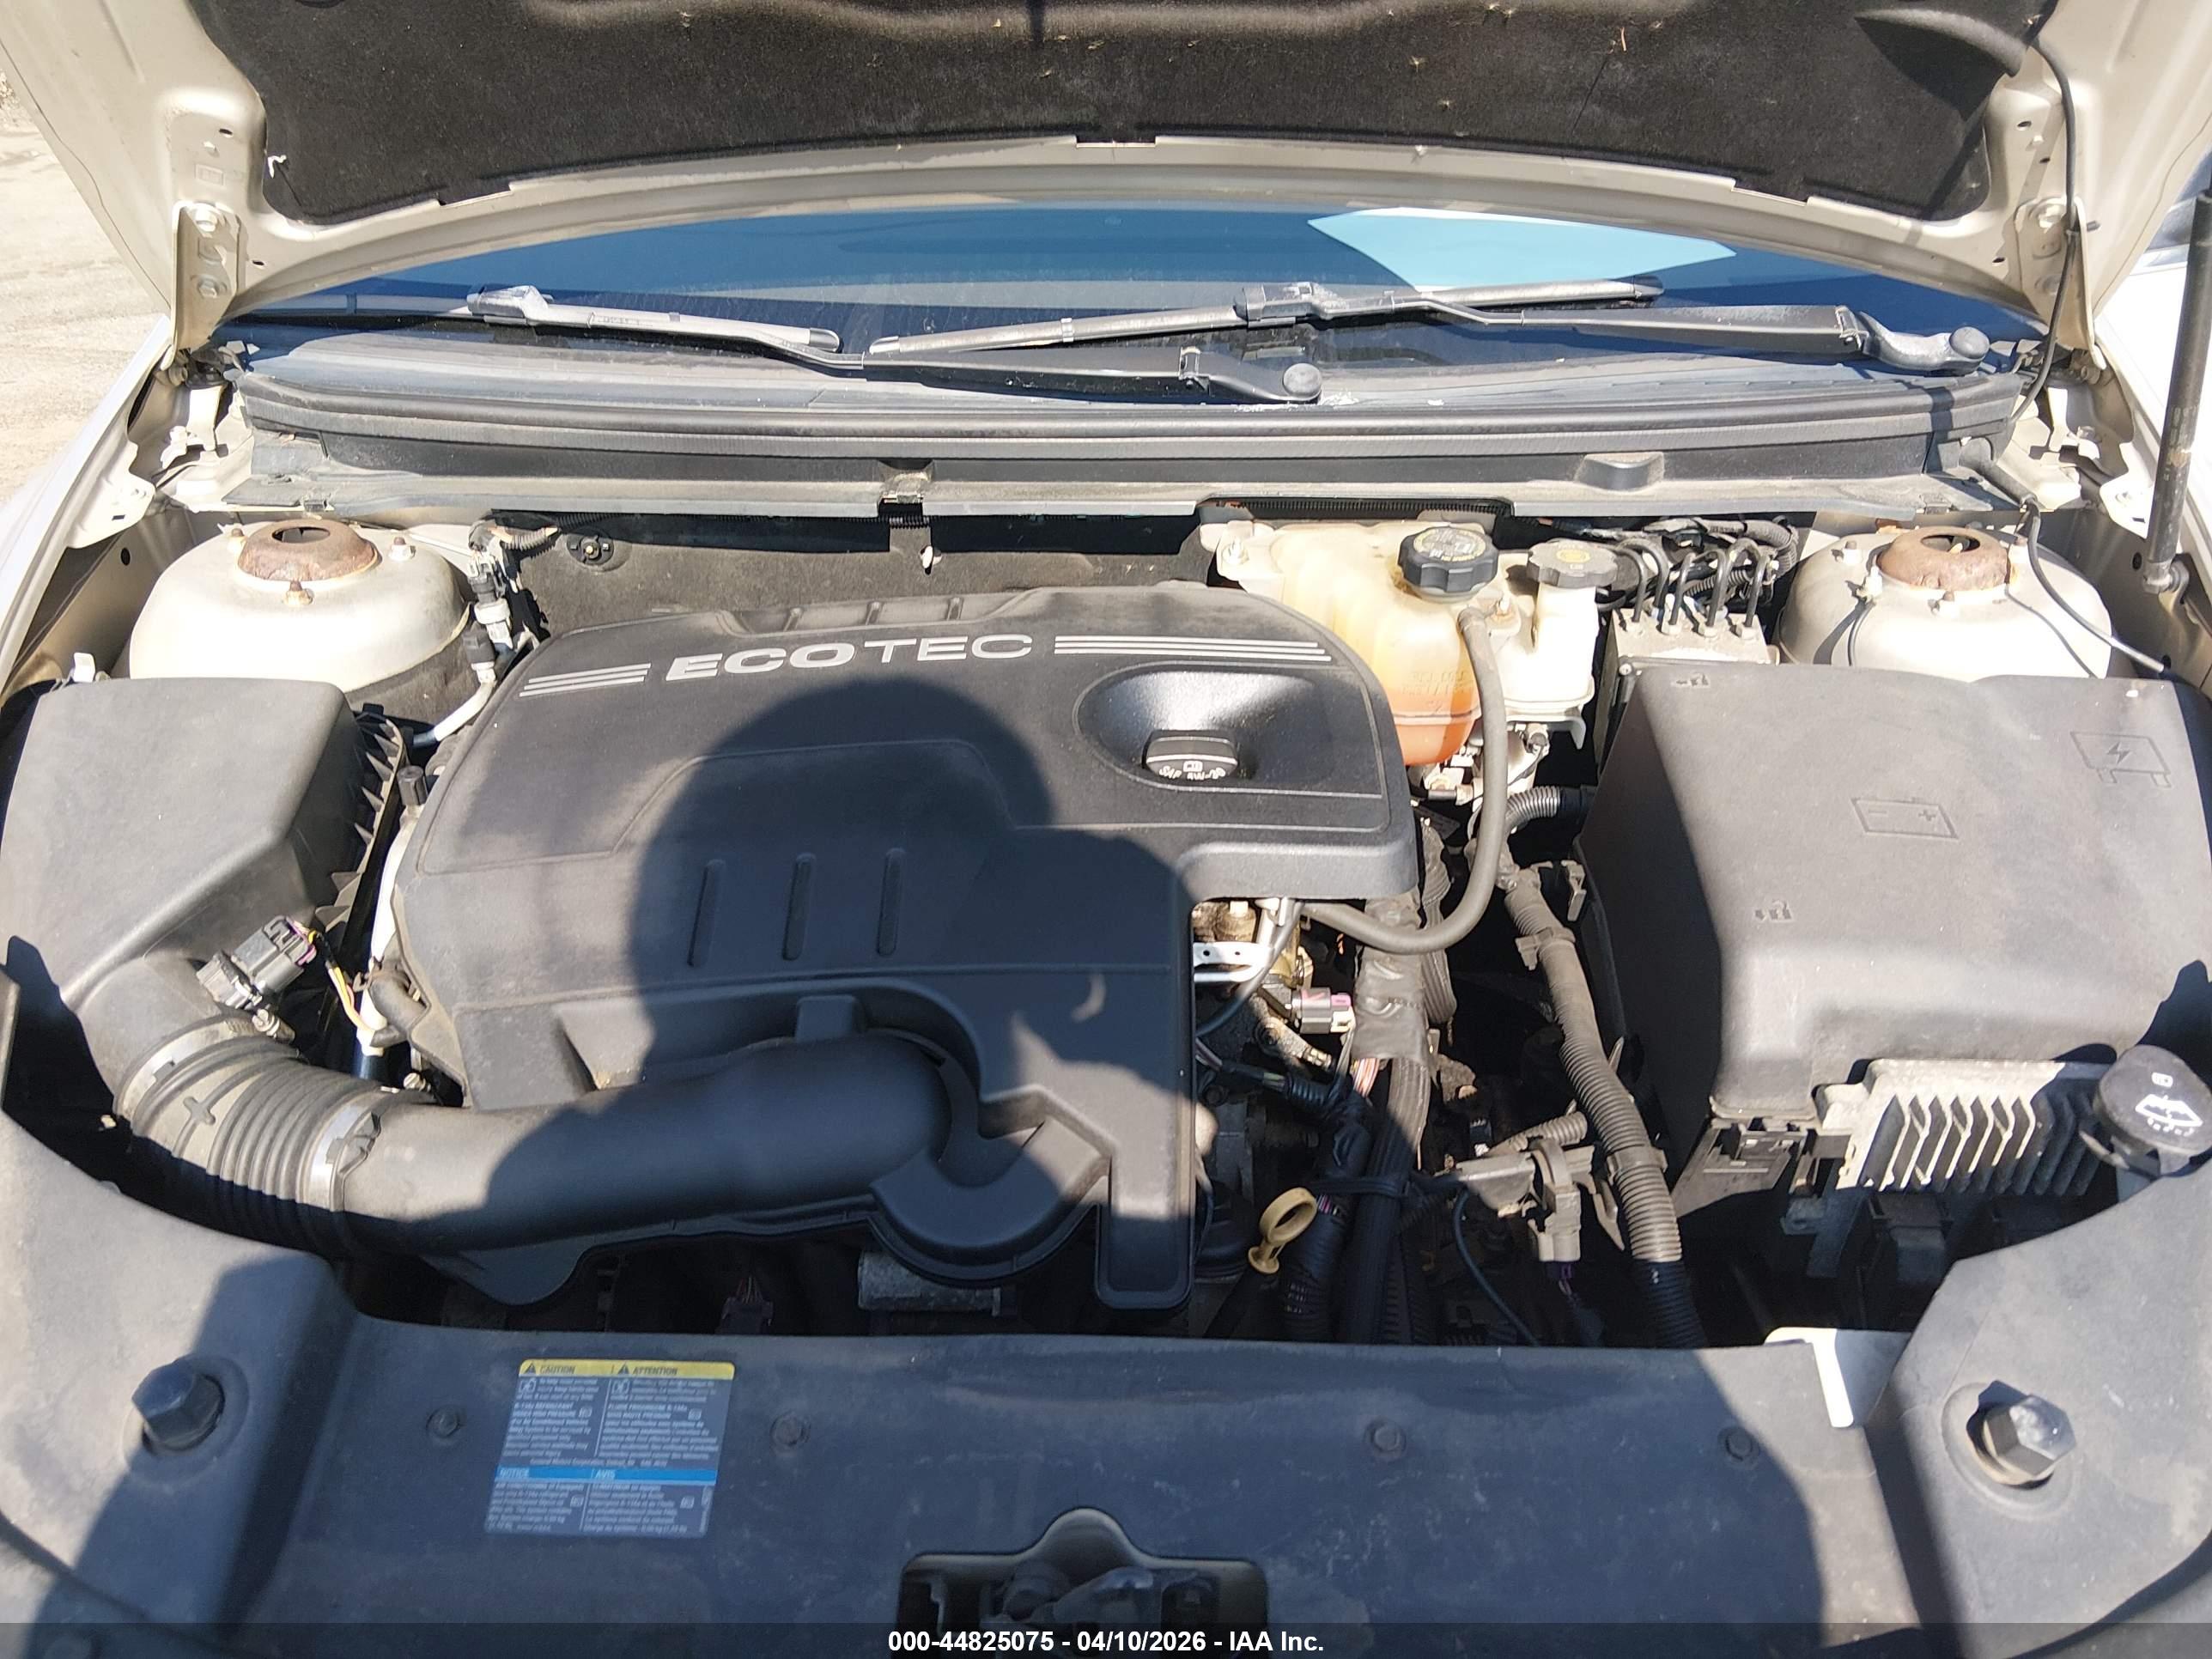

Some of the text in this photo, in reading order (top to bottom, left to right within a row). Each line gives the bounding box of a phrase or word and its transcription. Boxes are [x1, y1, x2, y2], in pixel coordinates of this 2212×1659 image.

[665, 634, 1033, 682] ECOTEC
[540, 1364, 576, 1375] CAUTION
[632, 1366, 678, 1376] ATTENTION
[500, 1468, 530, 1478] NOTICE
[594, 1469, 616, 1480] AVIS
